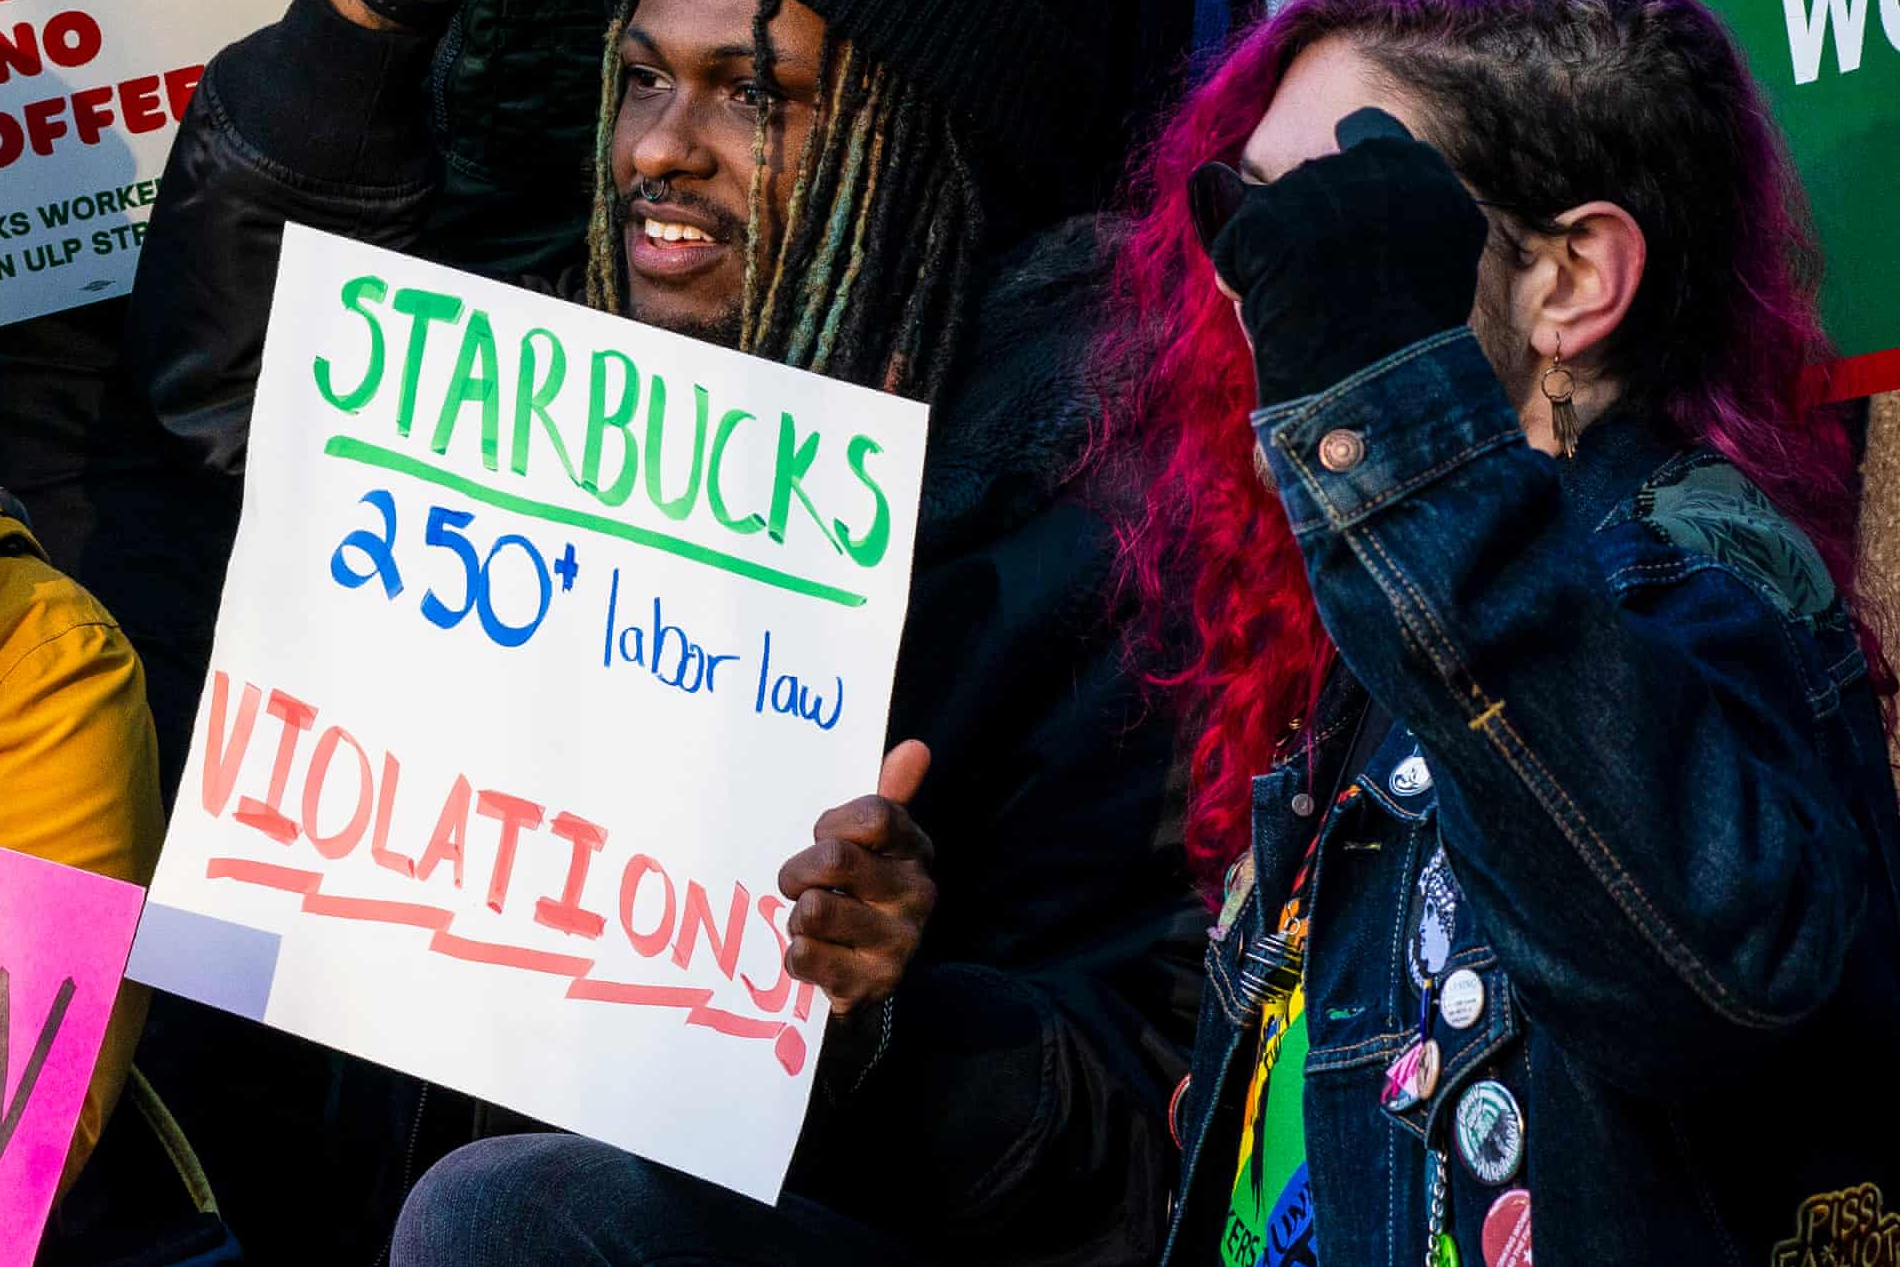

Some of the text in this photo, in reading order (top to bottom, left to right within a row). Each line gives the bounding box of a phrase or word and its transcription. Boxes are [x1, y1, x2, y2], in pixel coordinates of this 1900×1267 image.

[25, 236, 83, 273] ULP
[313, 274, 892, 569] STARBUCKS
[330, 489, 844, 731] 250+ labor law
